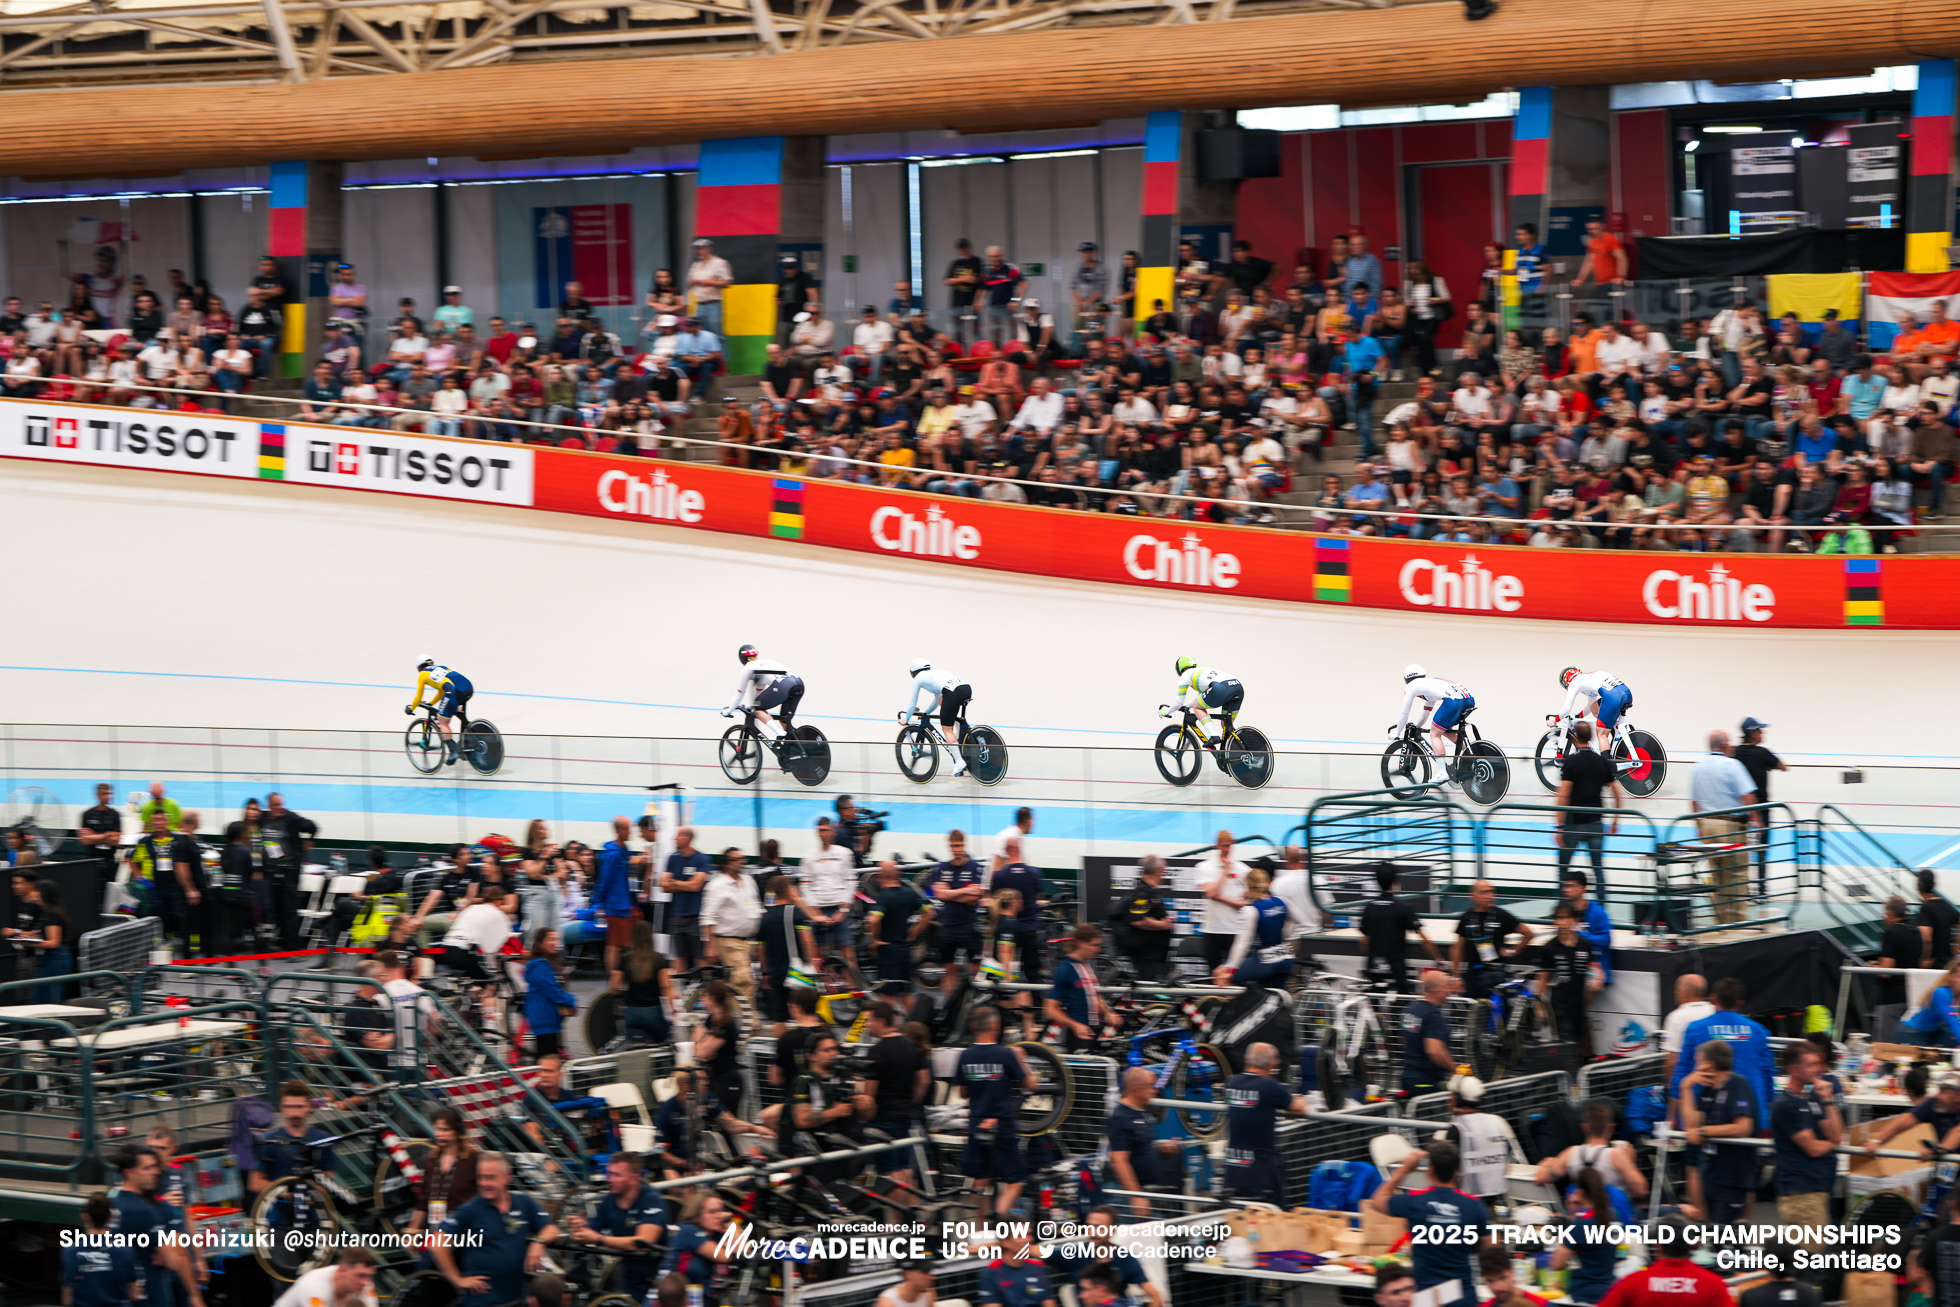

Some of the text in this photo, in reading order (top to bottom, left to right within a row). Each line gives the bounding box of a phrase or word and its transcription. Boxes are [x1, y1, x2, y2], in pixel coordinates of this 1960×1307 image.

[89, 420, 239, 462] TISSOT
[368, 445, 513, 491] TISSOT
[597, 469, 705, 523] Chile
[870, 503, 982, 560] Chile
[1123, 531, 1241, 589] Chile
[1398, 553, 1525, 612] Chile
[1642, 562, 1775, 621] Chile
[1648, 1276, 1698, 1294] MEX
